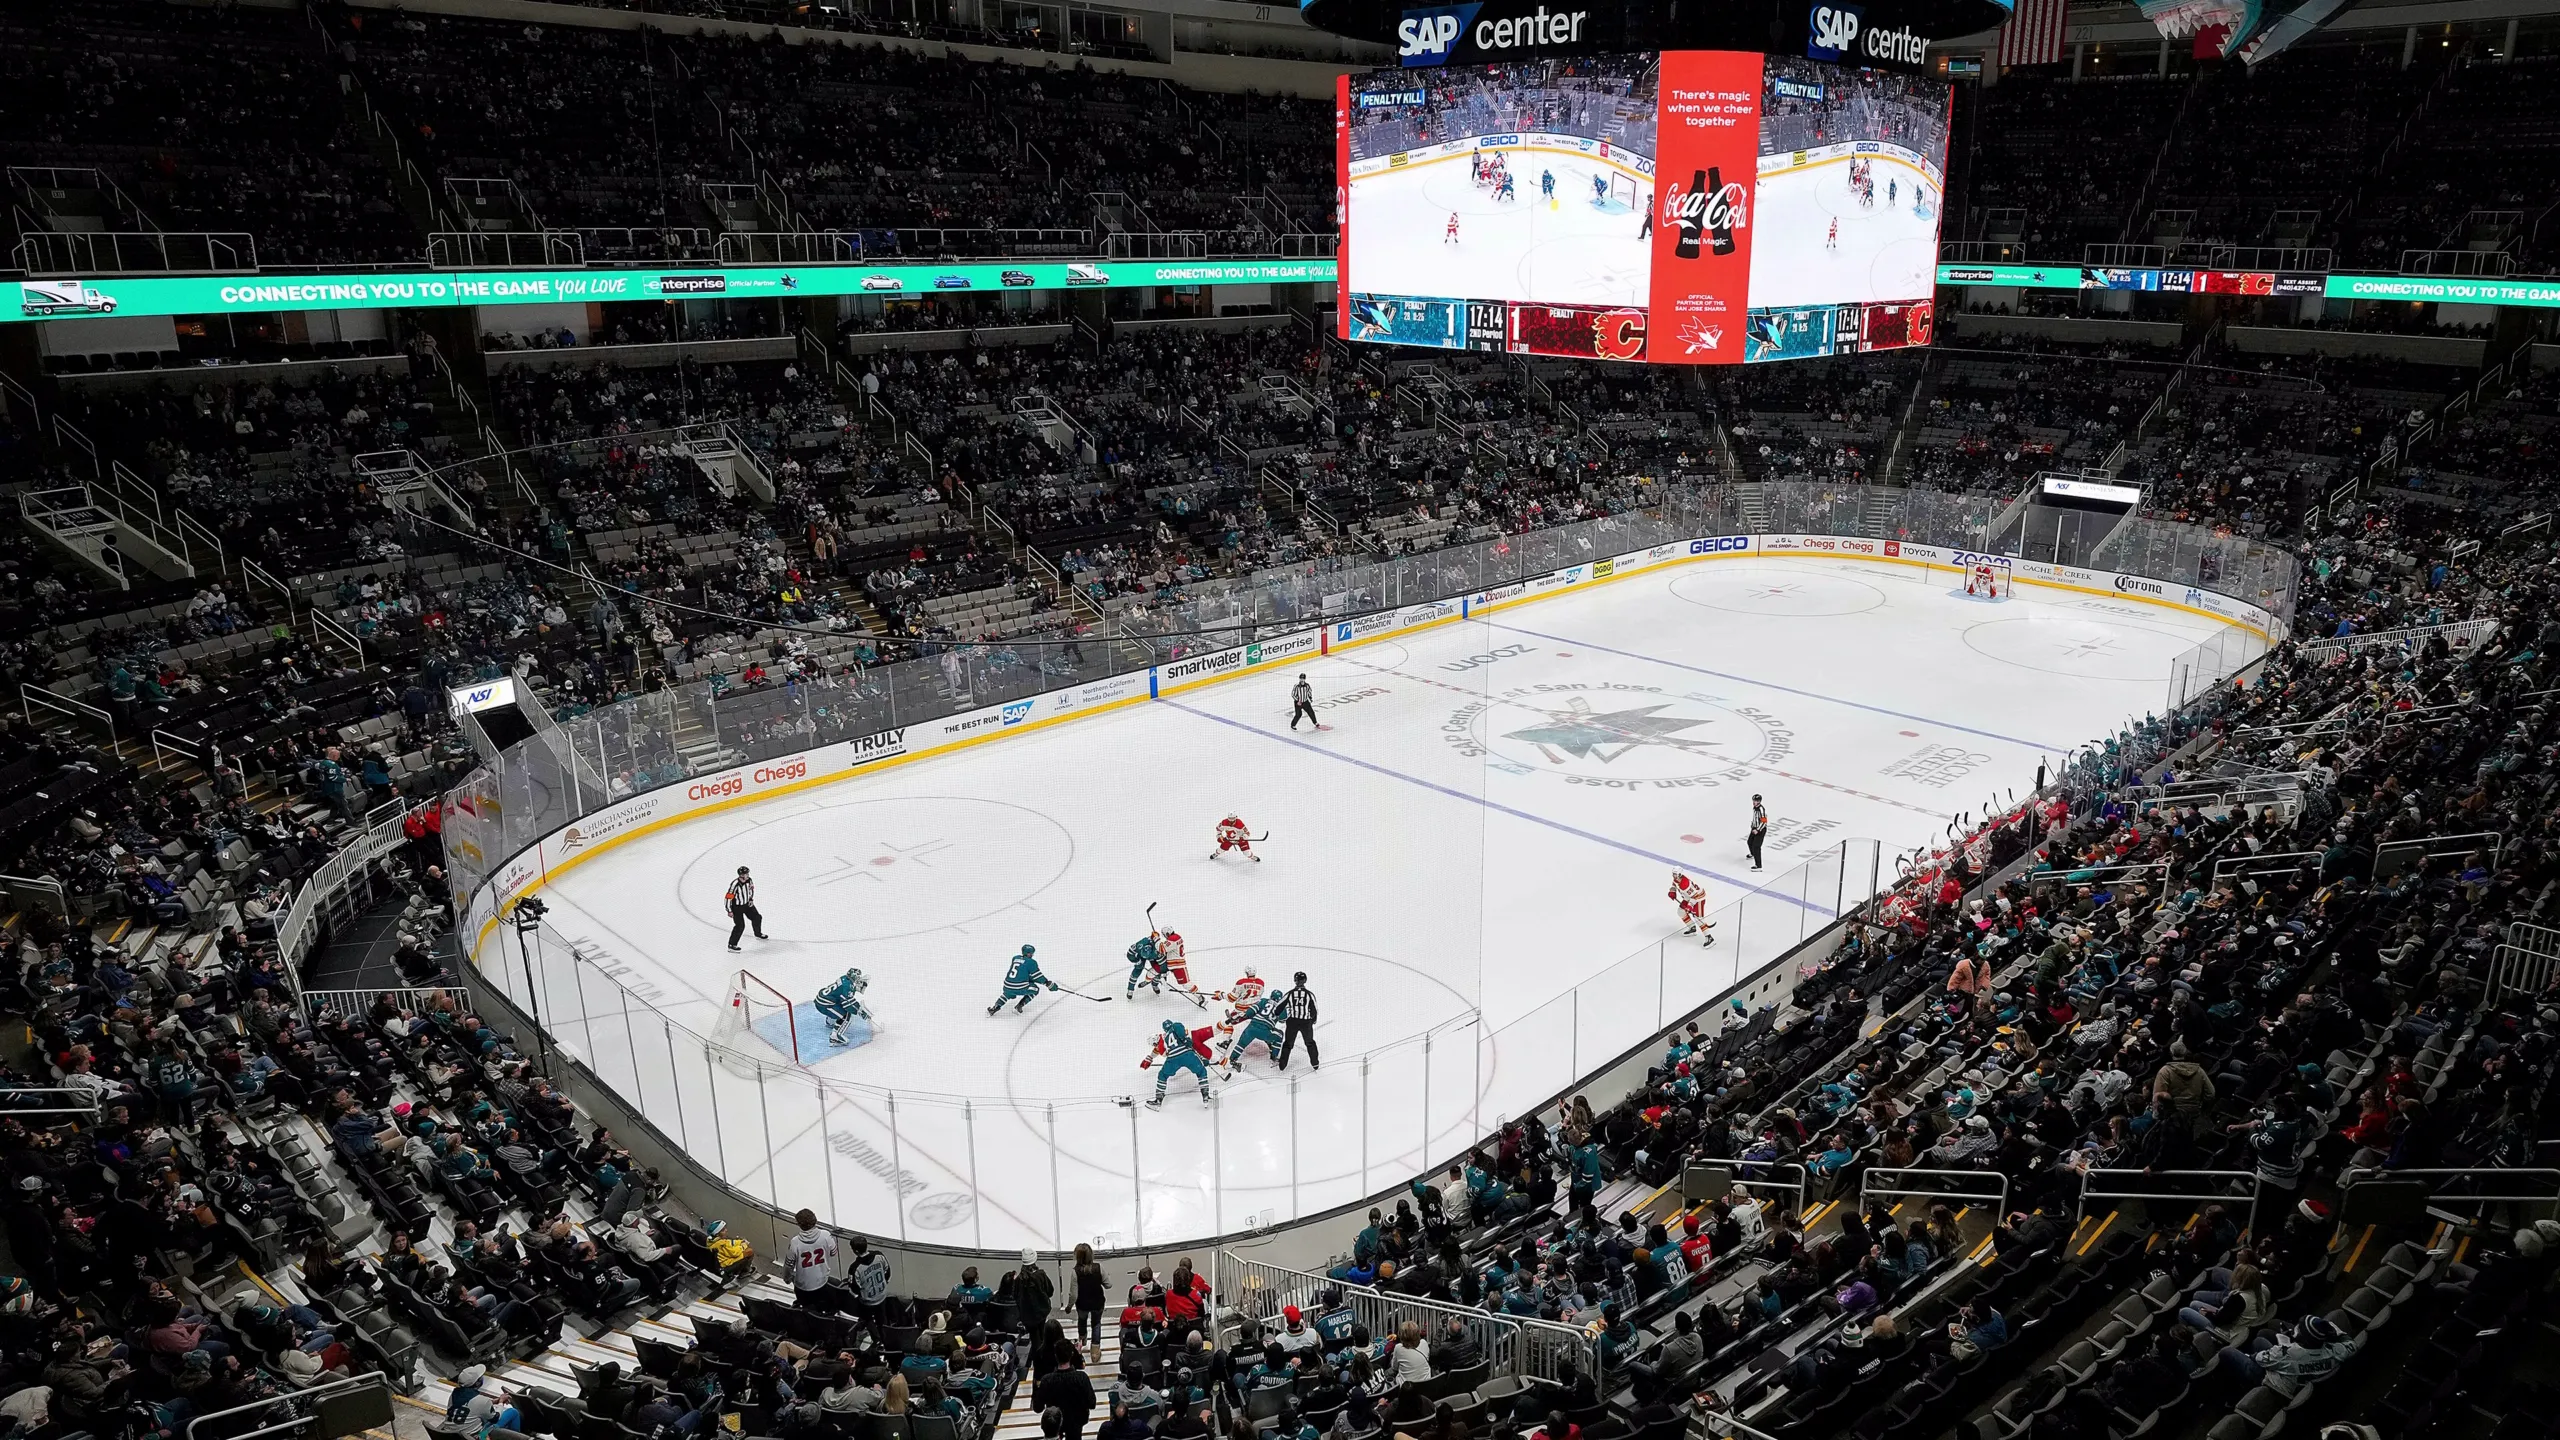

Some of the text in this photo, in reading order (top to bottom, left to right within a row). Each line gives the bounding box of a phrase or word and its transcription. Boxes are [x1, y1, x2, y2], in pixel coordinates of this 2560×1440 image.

[1256, 6, 1270, 20] 217
[1398, 5, 1586, 57] SAP center
[1815, 6, 1931, 65] SAP center
[1363, 90, 1422, 107] PENALTY KILL
[1672, 90, 1751, 102] There's magic
[1776, 81, 1822, 100] PENALTY KILL
[1667, 103, 1753, 114] when we cheer
[1686, 116, 1736, 128] together
[1480, 135, 1519, 147] GEICO
[1580, 140, 1591, 150] SAP
[1856, 142, 1880, 152] GEICO
[1610, 149, 1628, 162] TOYOTA
[1663, 182, 1747, 230] Coca-Cola
[1682, 237, 1701, 245] Real
[1155, 266, 1306, 280] CONNECTING YOU TO THE GAME
[1941, 271, 1993, 280] enterprise
[2140, 272, 2147, 290] 1
[2161, 272, 2191, 285] 17:14
[220, 278, 628, 303] CONNECTING YOU TO THE GAME LOVE
[648, 278, 725, 292] enterprise
[729, 279, 776, 288] Official Partner
[2200, 273, 2207, 292] 1
[2352, 282, 2526, 299] CONNECTING YOU TO THE
[1404, 302, 1427, 311] PENALTY
[1549, 309, 1574, 319] PENALTY
[1446, 304, 1455, 337] 1
[1469, 305, 1503, 328] 17:14
[1511, 307, 1520, 341] 1
[1838, 309, 1859, 331] 17:14
[1863, 308, 1870, 340] 1
[1482, 329, 1503, 340] Period
[1822, 310, 1829, 344] 1
[1689, 536, 1749, 555] GEICO
[1803, 538, 1835, 551] Chegg
[1841, 540, 1874, 553] Chegg
[1903, 546, 1938, 559] TOYOTA
[1594, 564, 1612, 575] DGDG
[1622, 558, 1635, 567] HAPPY
[1546, 578, 1556, 586] BEST
[1566, 569, 1580, 582] SAP
[2022, 565, 2092, 581] CACHE CREEK
[1507, 585, 1526, 599] LIGHT
[2114, 575, 2163, 595] Corona
[1353, 611, 1397, 628] PACIFIC OFFICE
[1353, 619, 1392, 635] AUTOMATION
[1250, 636, 1313, 659] enterprise
[1167, 650, 1242, 680] smartwater
[1437, 643, 1539, 672] zoom
[1082, 677, 1136, 696] Northern California
[1501, 681, 1663, 699] at San Jose
[467, 688, 493, 705] NSI
[1082, 688, 1124, 704] Honda Dealers
[944, 704, 1028, 734] THE BEST RUN SAP
[1440, 701, 1488, 758] SAP Center
[1735, 706, 1796, 766] SAP Center
[850, 728, 907, 754] TRULY
[855, 744, 903, 761] HARD SELTZER
[753, 760, 807, 784] Chegg
[1892, 747, 1966, 781] CREEK
[1918, 753, 1992, 789] CACHE
[687, 776, 743, 801] Chegg
[1564, 768, 1752, 792] at San Jose
[582, 798, 659, 835] CHUKCHANSI GOLD
[591, 823, 616, 839] RESORT
[625, 809, 652, 824] CASINO
[1765, 818, 1842, 852] Western
[1008, 962, 1021, 979] 5
[159, 1063, 185, 1085] 62
[238, 1202, 252, 1216] 19
[800, 1248, 825, 1269] 22
[1663, 1250, 1681, 1262] BURNS
[1666, 1255, 1688, 1284] 88
[864, 1271, 886, 1299] 39
[1327, 1311, 1353, 1328] MARLEAU
[1234, 1351, 1266, 1365] THORNTON
